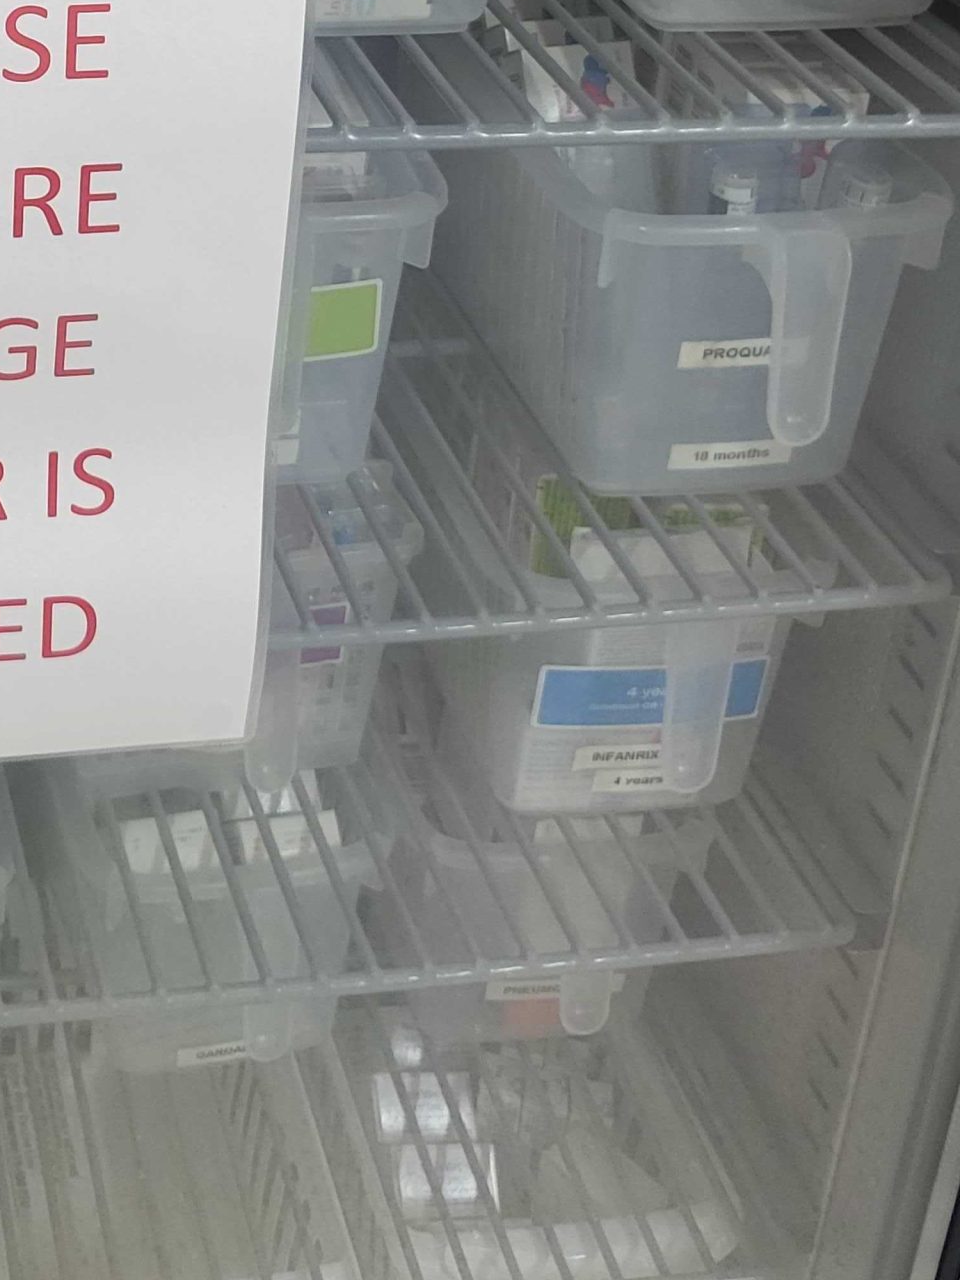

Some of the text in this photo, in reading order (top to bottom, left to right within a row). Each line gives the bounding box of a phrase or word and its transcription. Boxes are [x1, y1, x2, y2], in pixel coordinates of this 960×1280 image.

[703, 347, 771, 360] PROQUA
[713, 448, 771, 461] months
[47, 448, 117, 518] IS
[592, 750, 660, 762] INFANRIX
[625, 775, 664, 785] years
